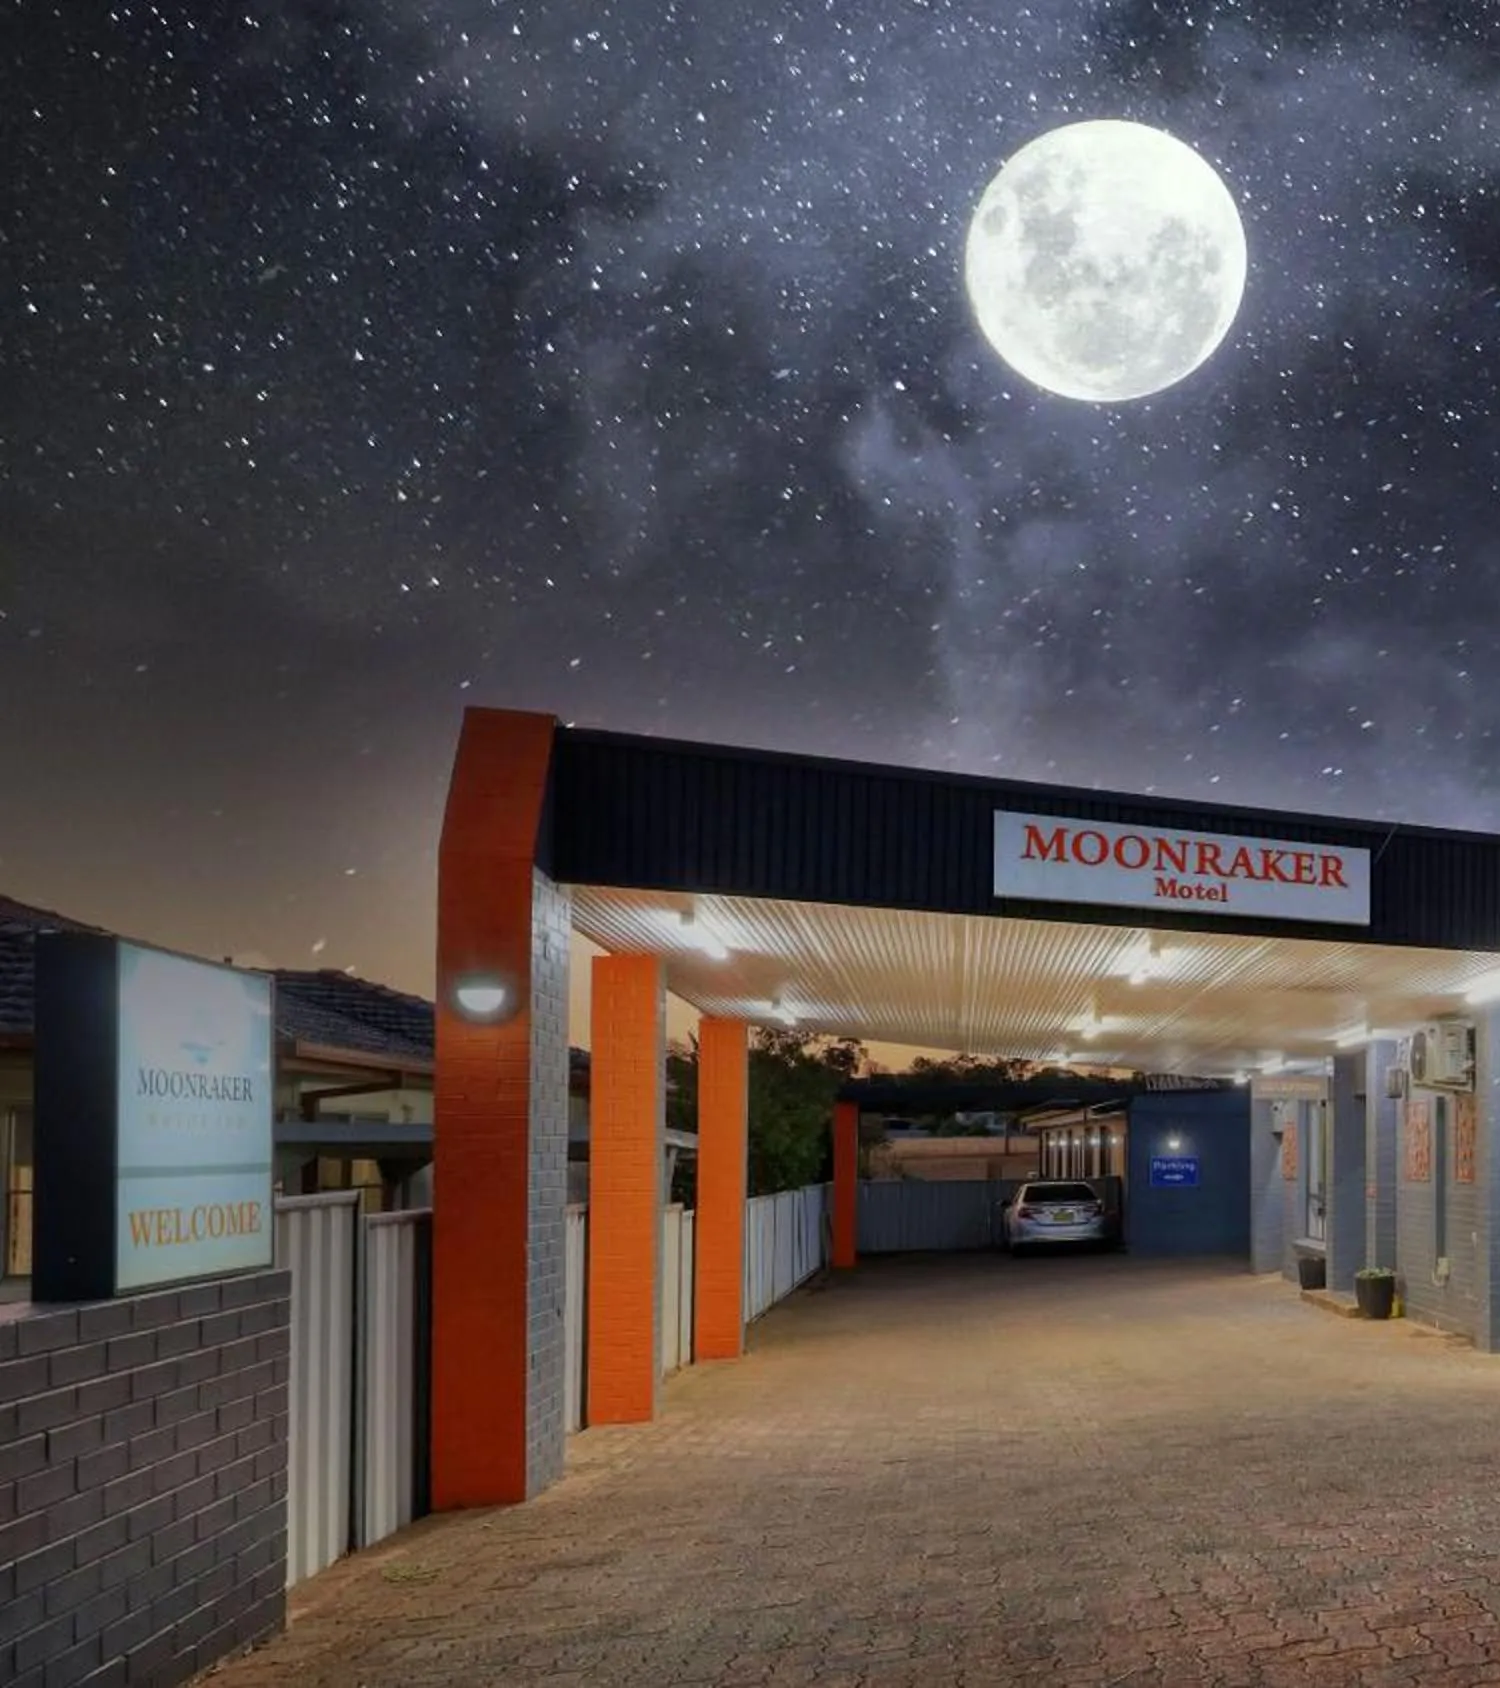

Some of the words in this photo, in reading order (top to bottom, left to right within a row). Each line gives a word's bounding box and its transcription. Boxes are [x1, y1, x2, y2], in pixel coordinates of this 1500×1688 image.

[1020, 824, 1349, 888] MOONRAKER
[1154, 877, 1228, 903] Motel
[137, 1067, 254, 1102] MOONRAKER
[128, 1202, 263, 1250] WELCOME
